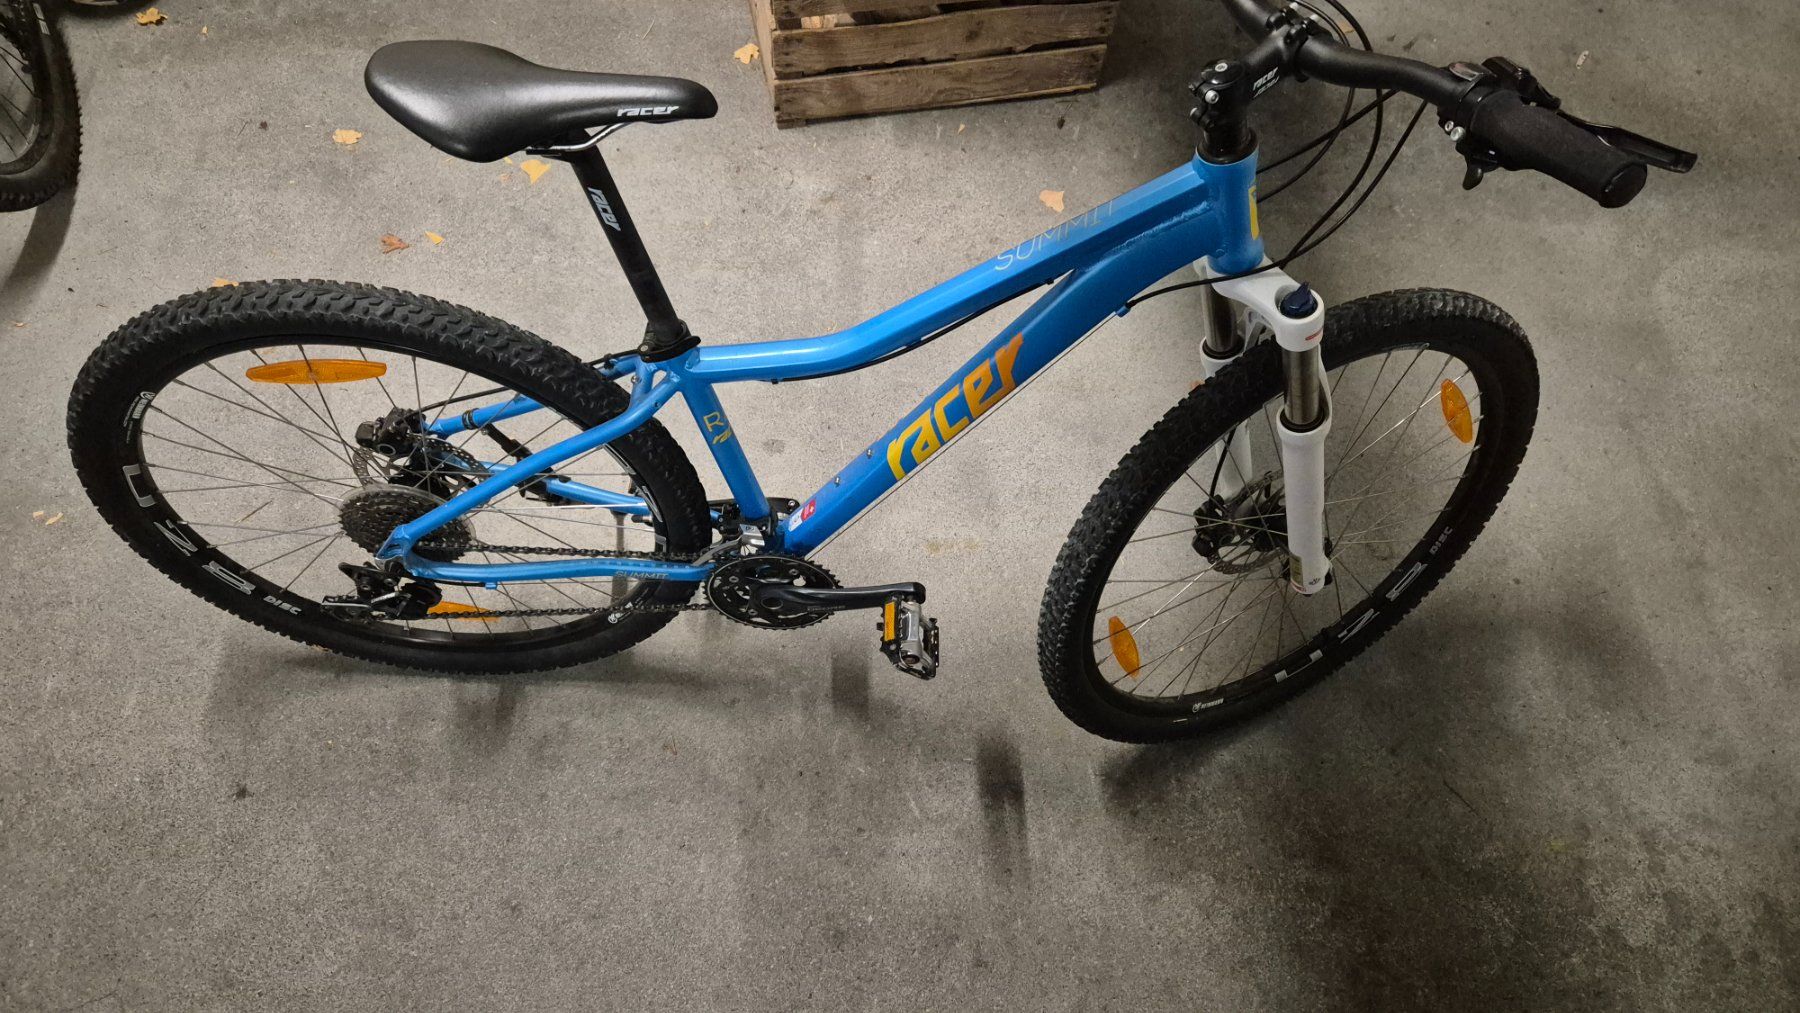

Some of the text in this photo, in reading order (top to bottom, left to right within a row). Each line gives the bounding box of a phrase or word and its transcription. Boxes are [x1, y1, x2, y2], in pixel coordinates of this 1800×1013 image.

[616, 105, 680, 117] racer
[587, 186, 621, 231] racer
[886, 331, 1024, 480] racer
